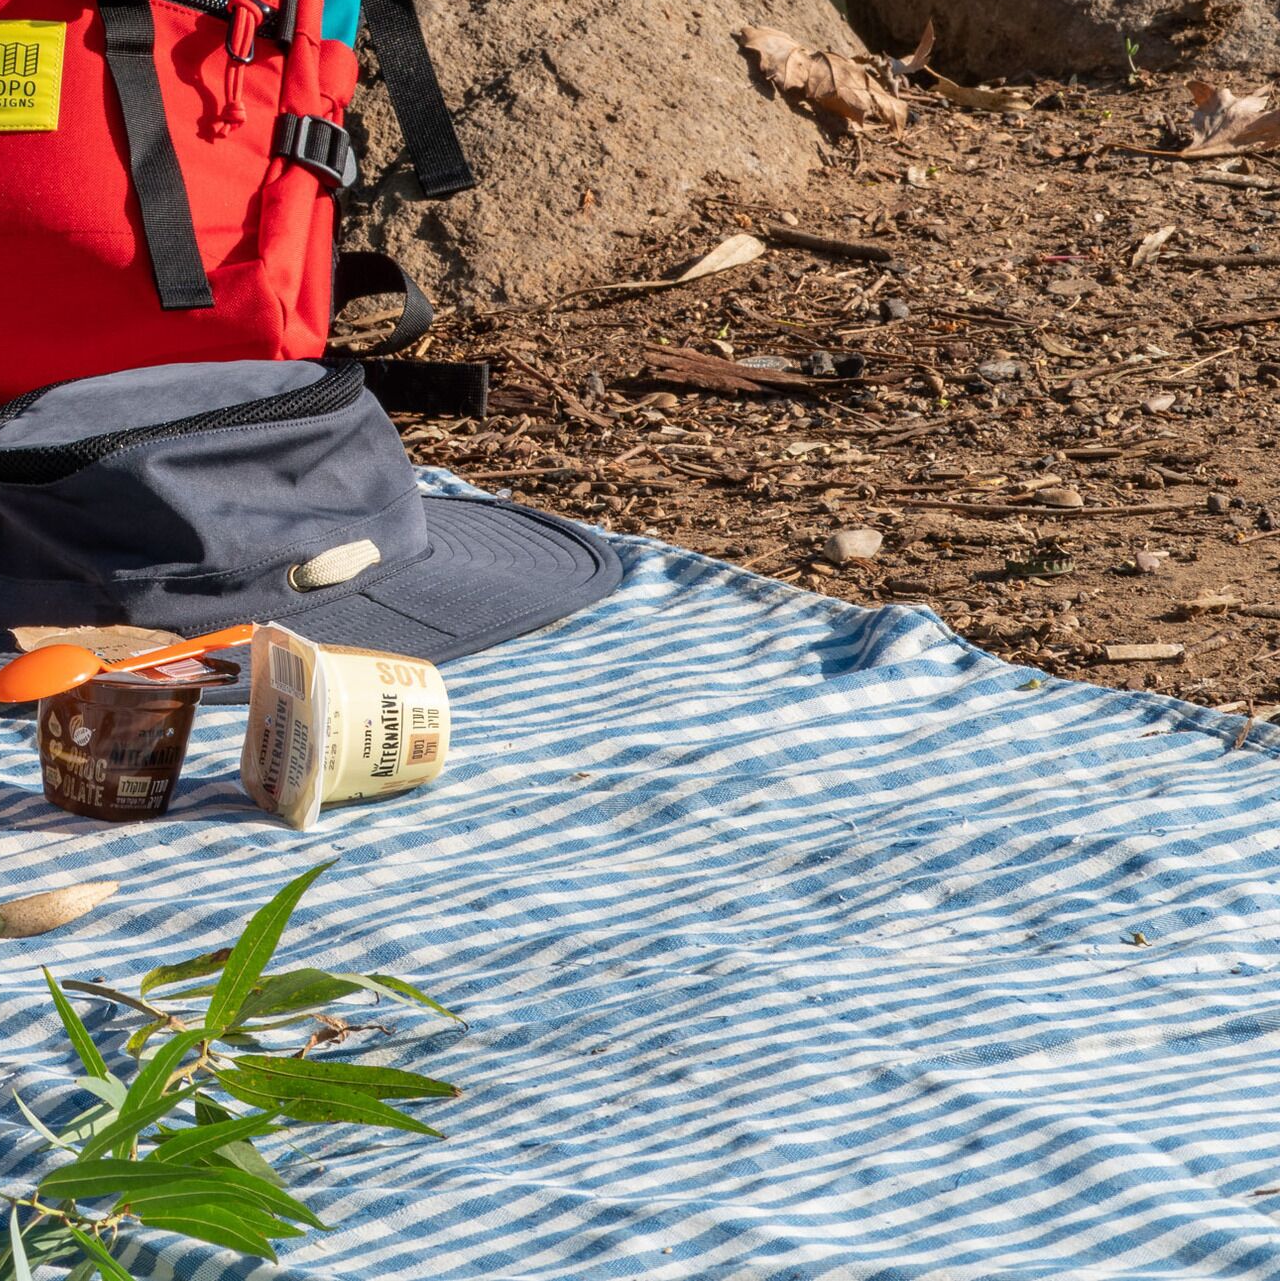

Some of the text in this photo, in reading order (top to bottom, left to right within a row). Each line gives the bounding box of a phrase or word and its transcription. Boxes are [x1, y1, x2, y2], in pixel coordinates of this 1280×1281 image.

[376, 662, 427, 688] SOY
[363, 729, 372, 758] תנובה
[63, 774, 104, 807] OLATE
